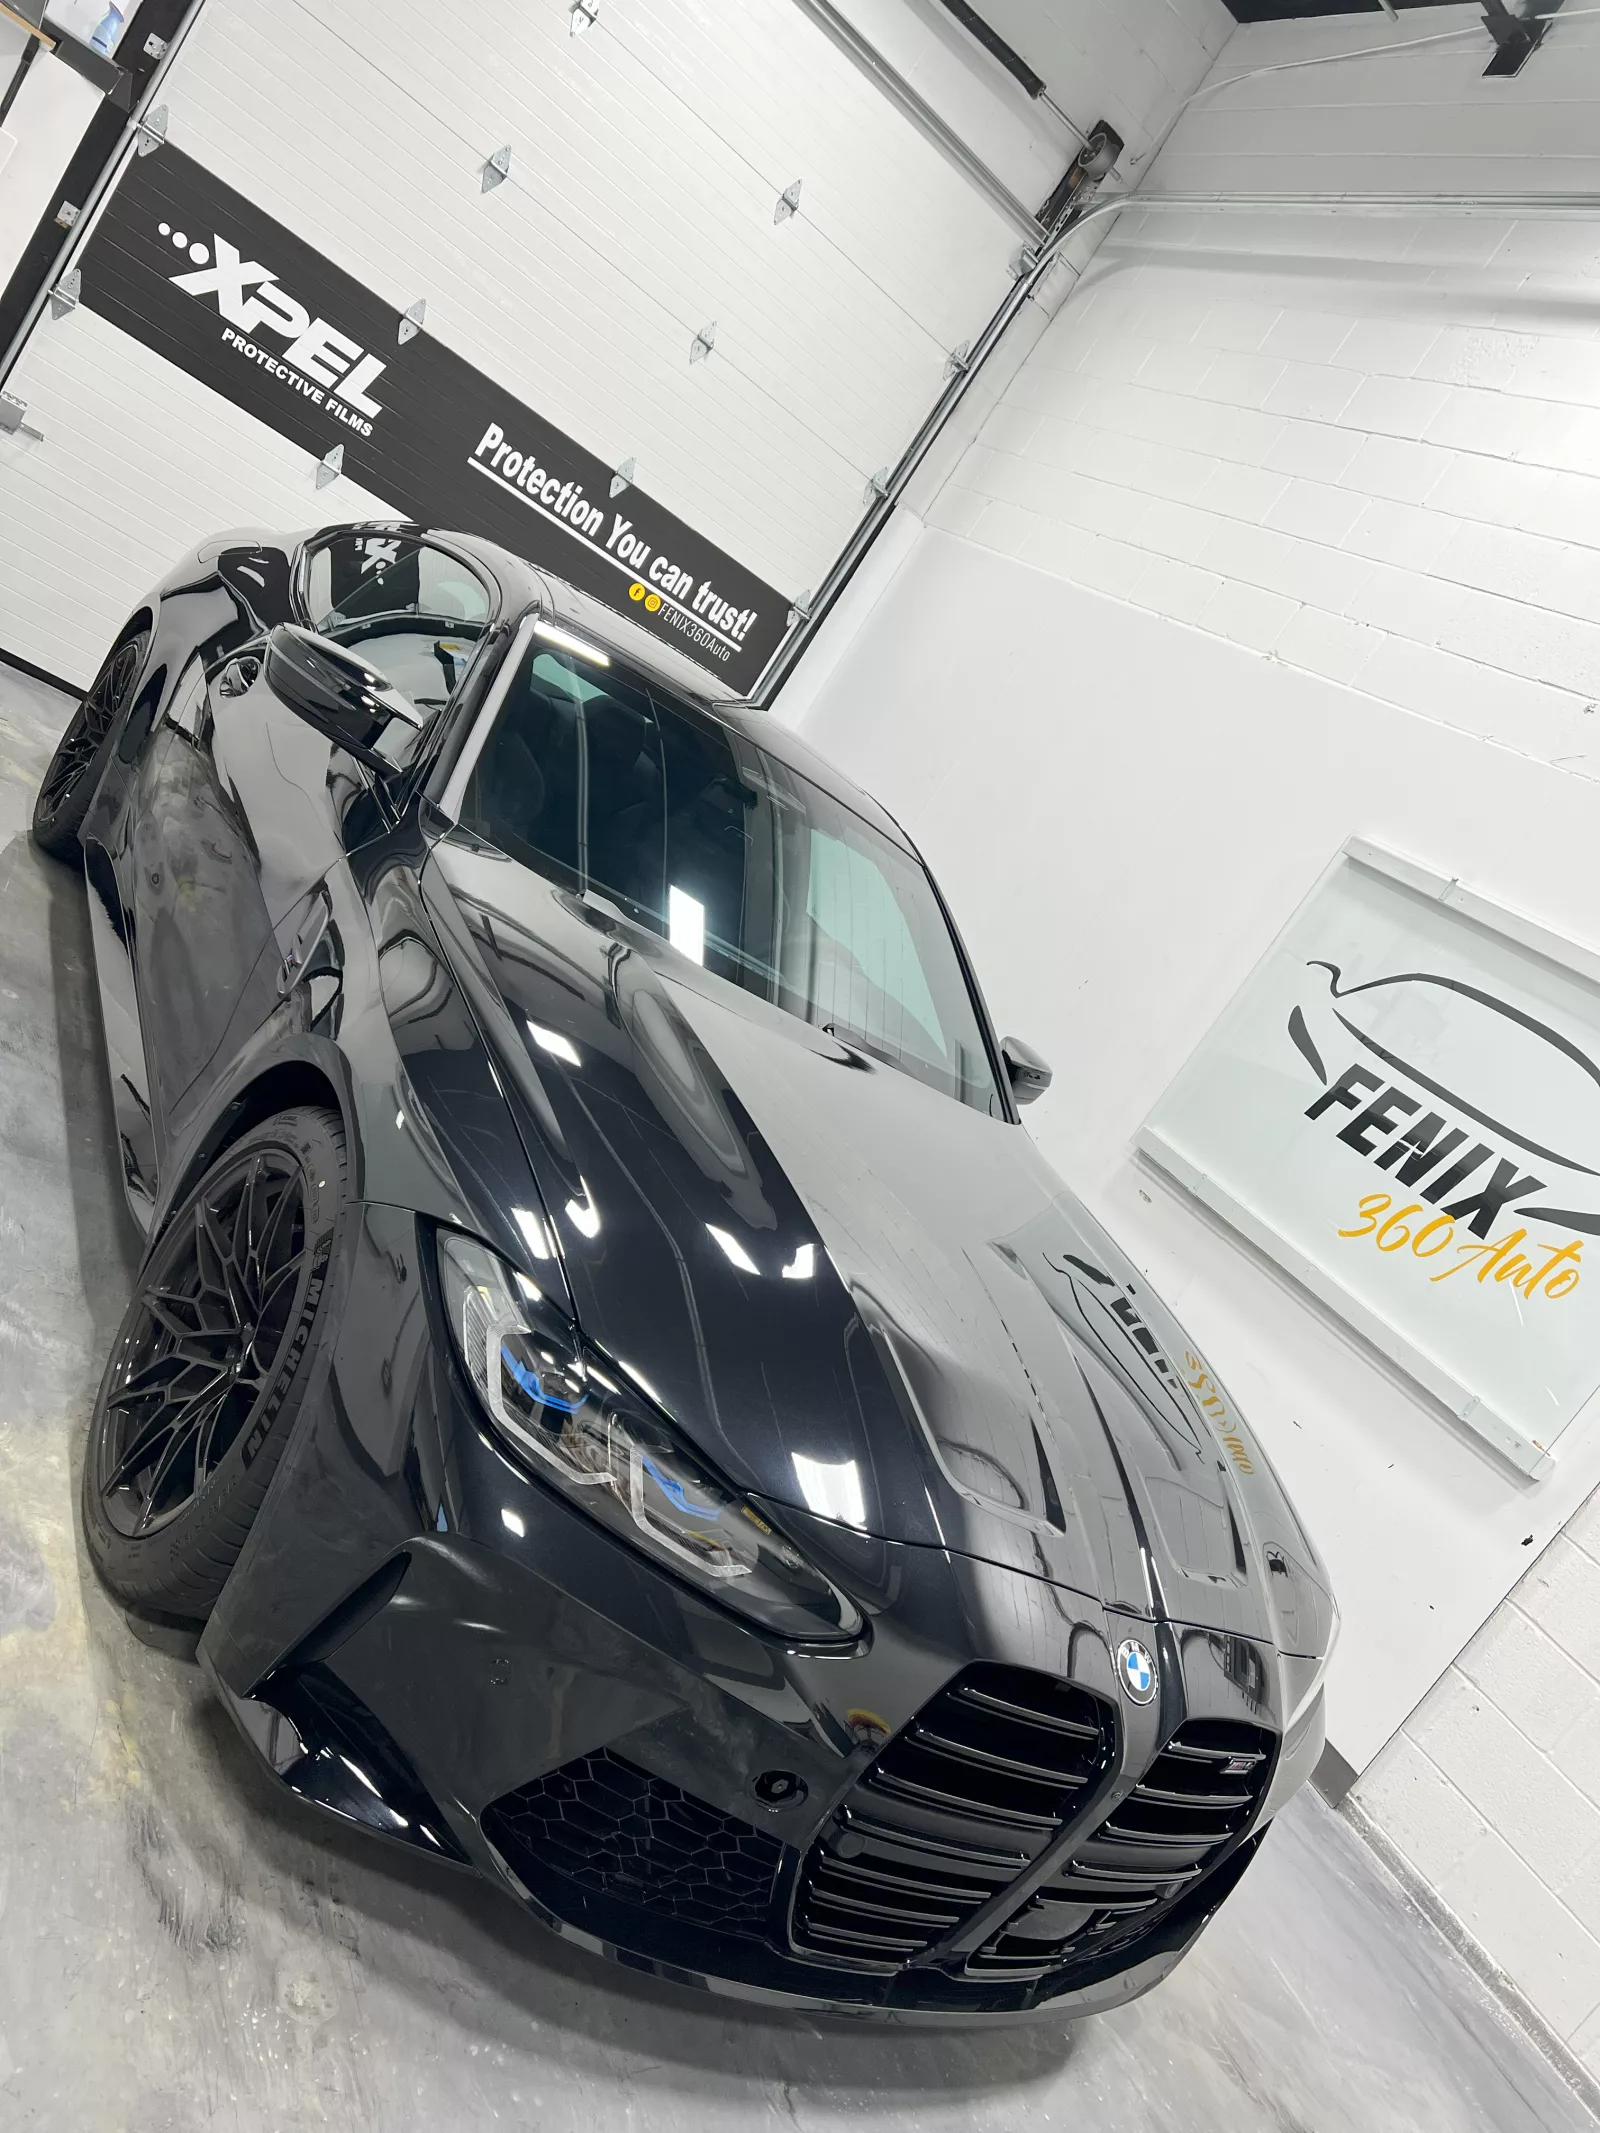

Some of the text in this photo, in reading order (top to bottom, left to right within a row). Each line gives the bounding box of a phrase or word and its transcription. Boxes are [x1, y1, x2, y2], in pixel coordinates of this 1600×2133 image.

[168, 233, 387, 419] XPEL
[221, 327, 374, 437] PROTECTIVE FILMS
[474, 422, 757, 641] Protection You can trust!
[658, 602, 731, 662] FENIX360Auto
[1303, 1063, 1547, 1240] FENIX
[1338, 1193, 1584, 1300] 360 Auto
[245, 1277, 323, 1460] MICHELIN
[1121, 1641, 1153, 1664] BMW
